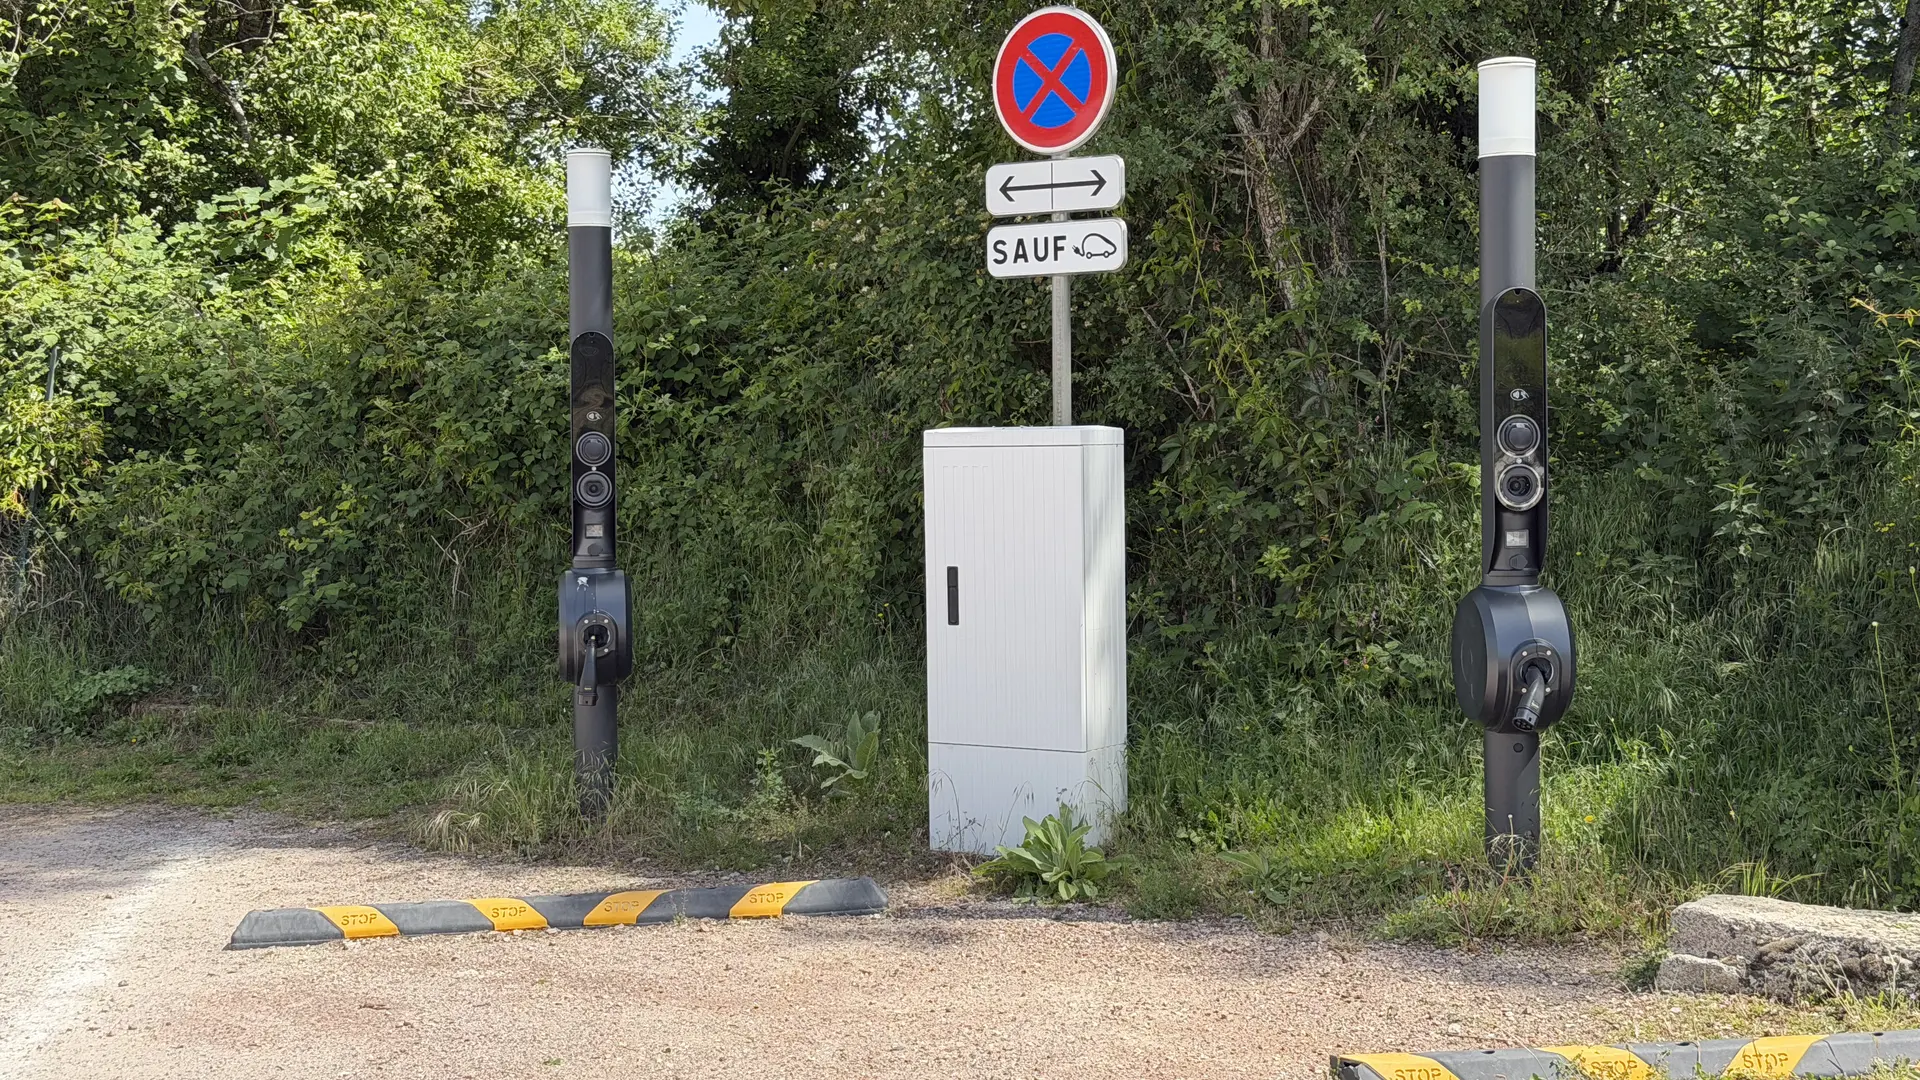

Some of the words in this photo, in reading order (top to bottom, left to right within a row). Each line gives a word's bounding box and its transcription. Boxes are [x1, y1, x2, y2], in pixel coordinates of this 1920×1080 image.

[992, 235, 1067, 265] SAUF
[749, 892, 784, 904] STOP
[491, 905, 527, 919] STOP
[604, 900, 640, 913] STOP
[341, 913, 378, 926] STOP
[1743, 1052, 1789, 1069] STOP
[1394, 1068, 1442, 1080] STOP
